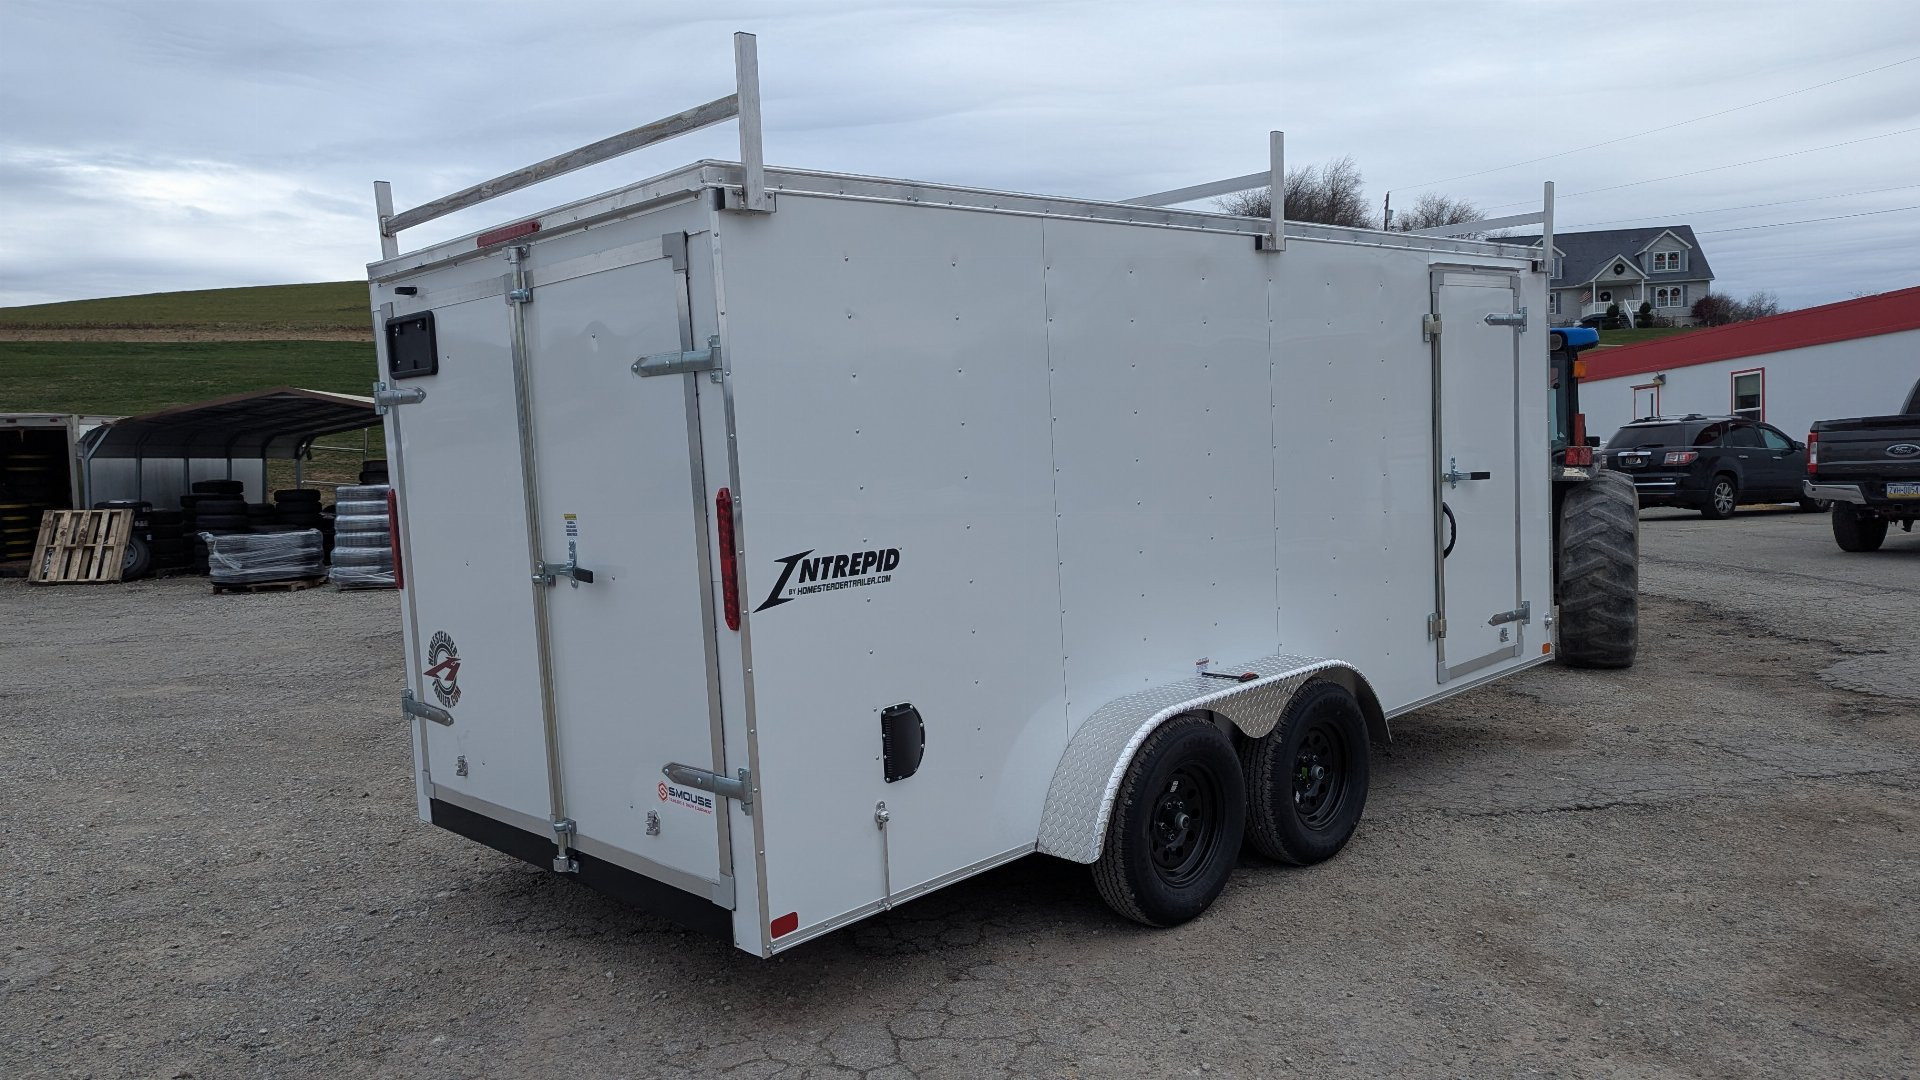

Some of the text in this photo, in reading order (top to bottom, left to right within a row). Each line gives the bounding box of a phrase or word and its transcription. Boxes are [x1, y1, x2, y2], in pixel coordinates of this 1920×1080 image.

[753, 548, 900, 613] INTREPID
[788, 574, 892, 596] BY HOMESTEADERTRAILER.COM
[428, 630, 458, 667] HOMESTEADER
[668, 786, 712, 808] SMOUSE
